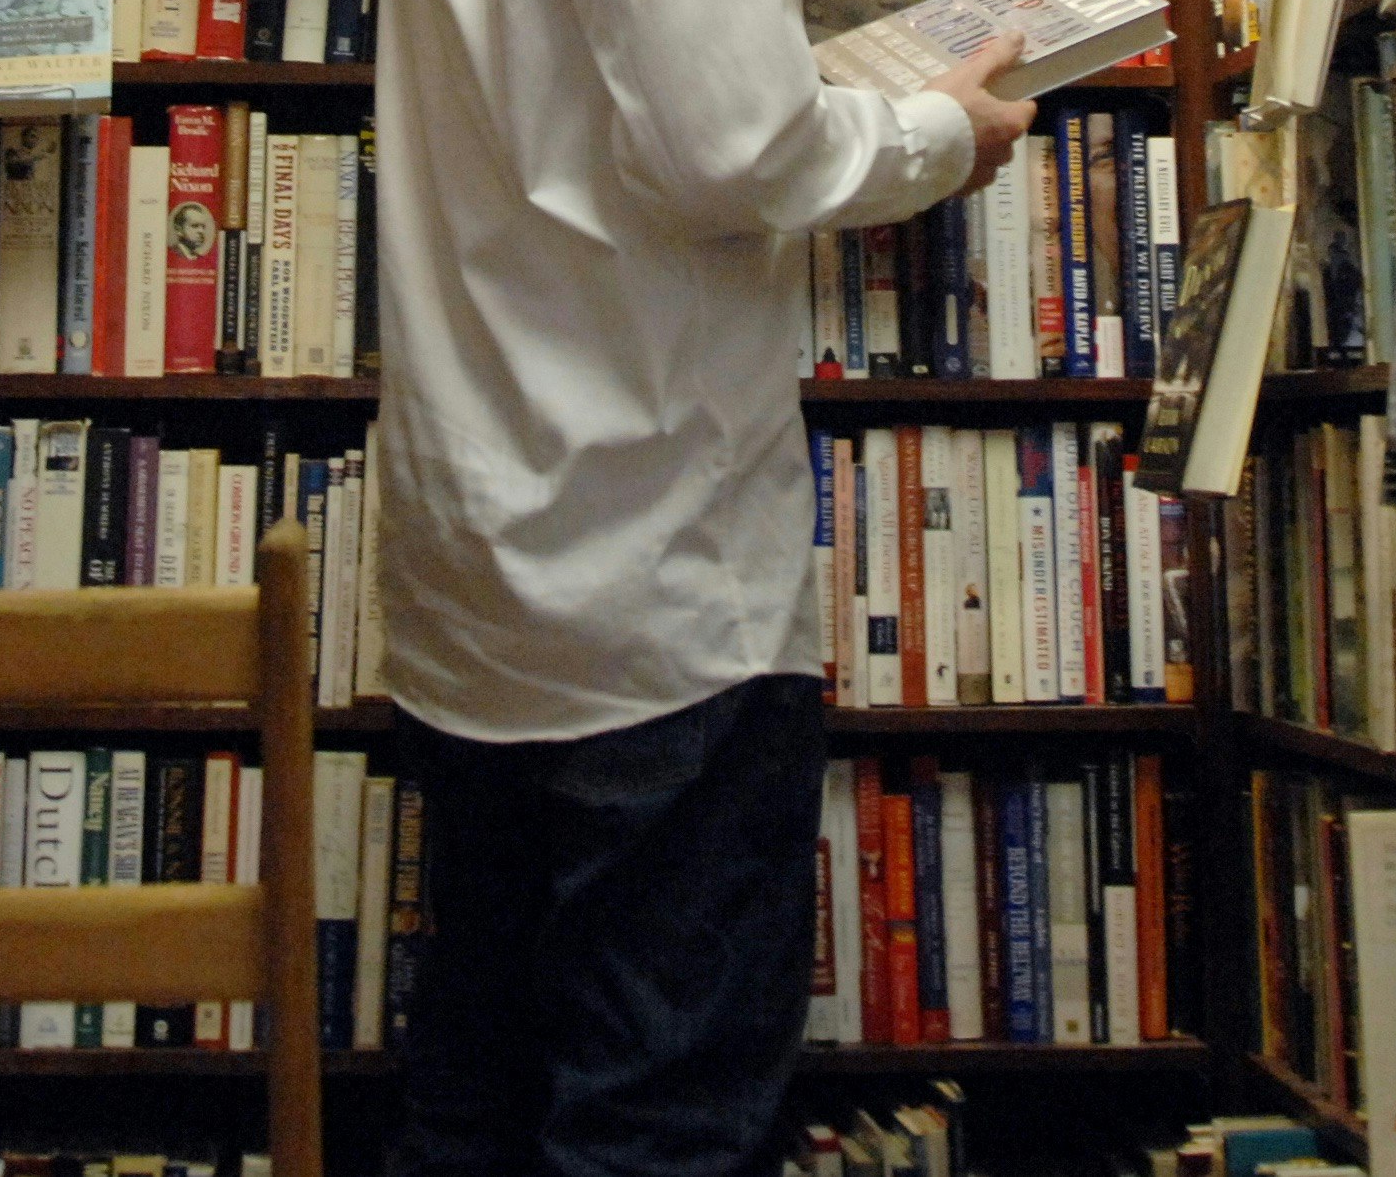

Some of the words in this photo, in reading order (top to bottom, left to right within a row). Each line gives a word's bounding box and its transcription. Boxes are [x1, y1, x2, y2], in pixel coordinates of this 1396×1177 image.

[1132, 133, 1145, 161] THE
[273, 154, 294, 204] FINAL
[339, 150, 356, 200] NIXON
[272, 208, 293, 250] DAYS
[1133, 167, 1149, 246] PRESIDENT
[338, 219, 354, 263] REAL
[1138, 251, 1150, 273] WE
[270, 259, 280, 287] CARL
[281, 260, 291, 282] BOB
[337, 267, 354, 320] PEACE
[269, 291, 279, 352] BERNSTEIN
[280, 287, 291, 353] WOODWARD
[1138, 278, 1152, 341] DESERVE
[1066, 492, 1079, 520] ON
[1068, 530, 1081, 568] THE
[1031, 525, 1051, 671] MISUNDERESTIMATED
[1070, 578, 1083, 653] COUCH
[34, 767, 73, 887] Dutc
[1007, 847, 1029, 904] BEYOND
[1008, 907, 1030, 939] THE
[1010, 941, 1032, 1002] BELTWAY
